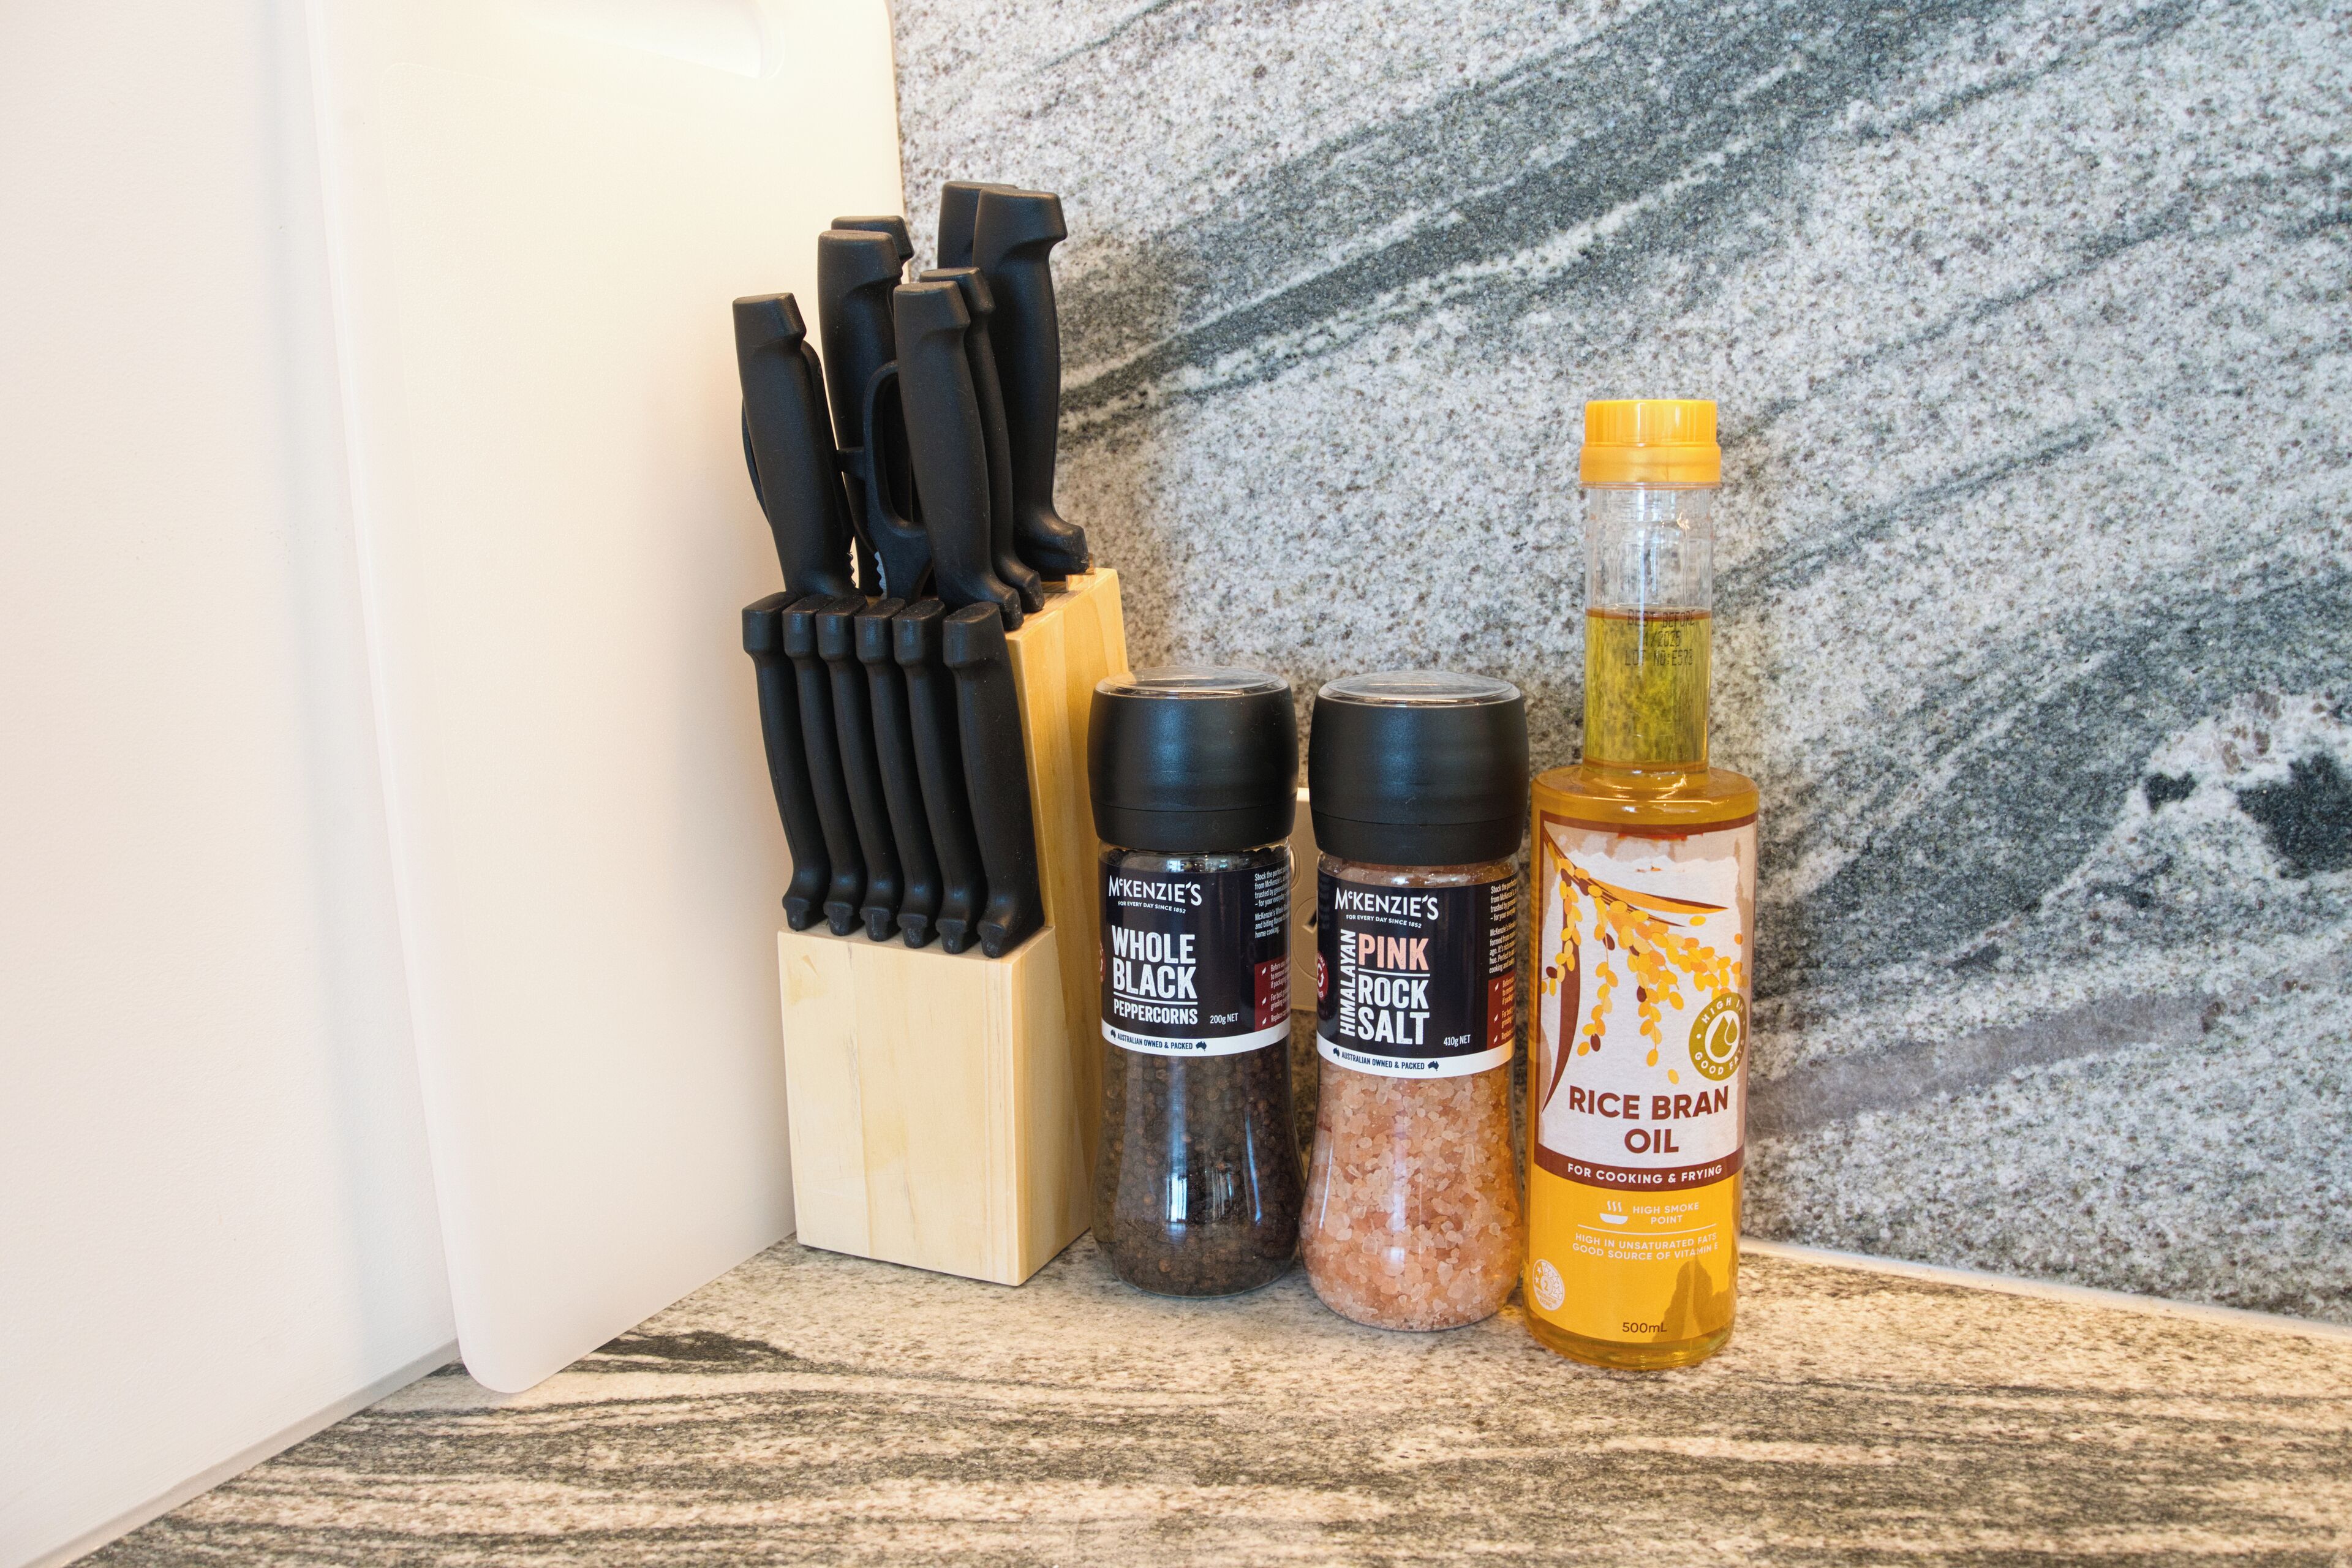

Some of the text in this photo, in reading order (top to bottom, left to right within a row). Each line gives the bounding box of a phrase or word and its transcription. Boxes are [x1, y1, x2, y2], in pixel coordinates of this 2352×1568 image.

[1627, 609, 1695, 628] BEST BEFORE
[1625, 649, 1646, 666] LOT
[1254, 872, 1266, 881] Stock
[1255, 889, 1268, 899] trusted
[1491, 884, 1501, 894] Stock
[1255, 909, 1275, 921] McKenzie's
[1490, 903, 1503, 913] trusted
[1263, 919, 1273, 928] biting
[1490, 925, 1509, 937] McKenzie's
[1255, 930, 1266, 938] home
[1490, 937, 1502, 946] formed
[1111, 924, 1196, 964] WHOLE
[1358, 933, 1429, 970] PINK
[1270, 963, 1281, 972] Before
[1489, 963, 1502, 973] cooking
[1113, 957, 1197, 999] BLACK
[1340, 929, 1355, 1037] HIMALAYAN
[1358, 974, 1429, 1009] ROCK
[1114, 998, 1198, 1024] PEPPERCORNS
[1702, 997, 1744, 1023] HIGH IN
[1210, 1013, 1238, 1025] 200g NET
[1358, 1007, 1430, 1045] SALT
[1117, 1033, 1143, 1046] AUSTRALIAN
[1144, 1039, 1163, 1049] OWNED
[1443, 1035, 1471, 1047] 410g NET
[1341, 1051, 1371, 1065] AUSTRALIAN
[1372, 1059, 1393, 1069] OWNED
[1695, 1052, 1724, 1075] GOOD
[1569, 1085, 1728, 1120] RICE BRAN
[1624, 1128, 1679, 1153] OIL
[1567, 1163, 1722, 1184] FOR COOKING & FRYING
[1632, 1202, 1699, 1215] HIGH SMOKE
[1650, 1215, 1683, 1225] POINT
[1575, 1232, 1717, 1250] HIGH IN UNSATURATED FATS
[1572, 1243, 1604, 1256] GOOD
[1608, 1250, 1653, 1260] SOURCE
[1656, 1251, 1670, 1260] OF
[1675, 1246, 1712, 1259] VITAMIN
[1544, 1280, 1548, 1291] 2
[1622, 1322, 1667, 1333] 500mL
